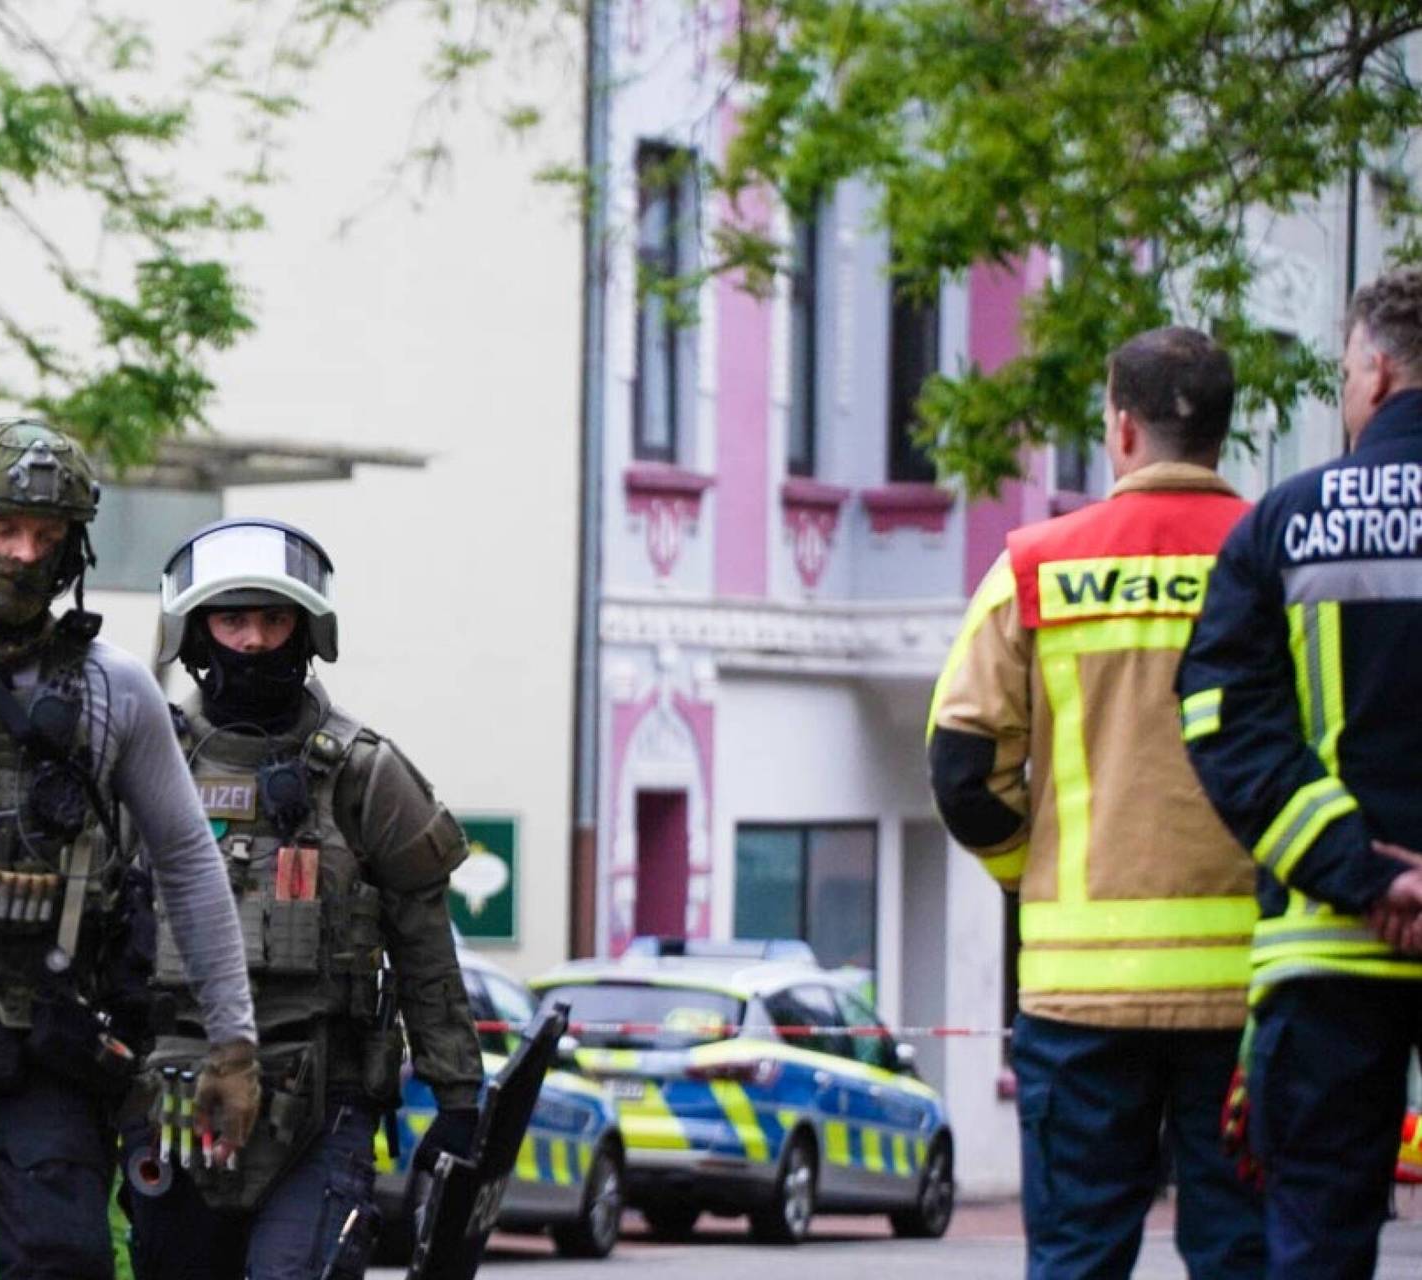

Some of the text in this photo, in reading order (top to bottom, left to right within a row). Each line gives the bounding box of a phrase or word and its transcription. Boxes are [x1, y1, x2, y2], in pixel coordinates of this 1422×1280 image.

[1321, 463, 1422, 510] FEUER
[1284, 508, 1422, 563] CASTROP
[1055, 568, 1199, 605] Wac
[200, 784, 252, 811] LIZEI
